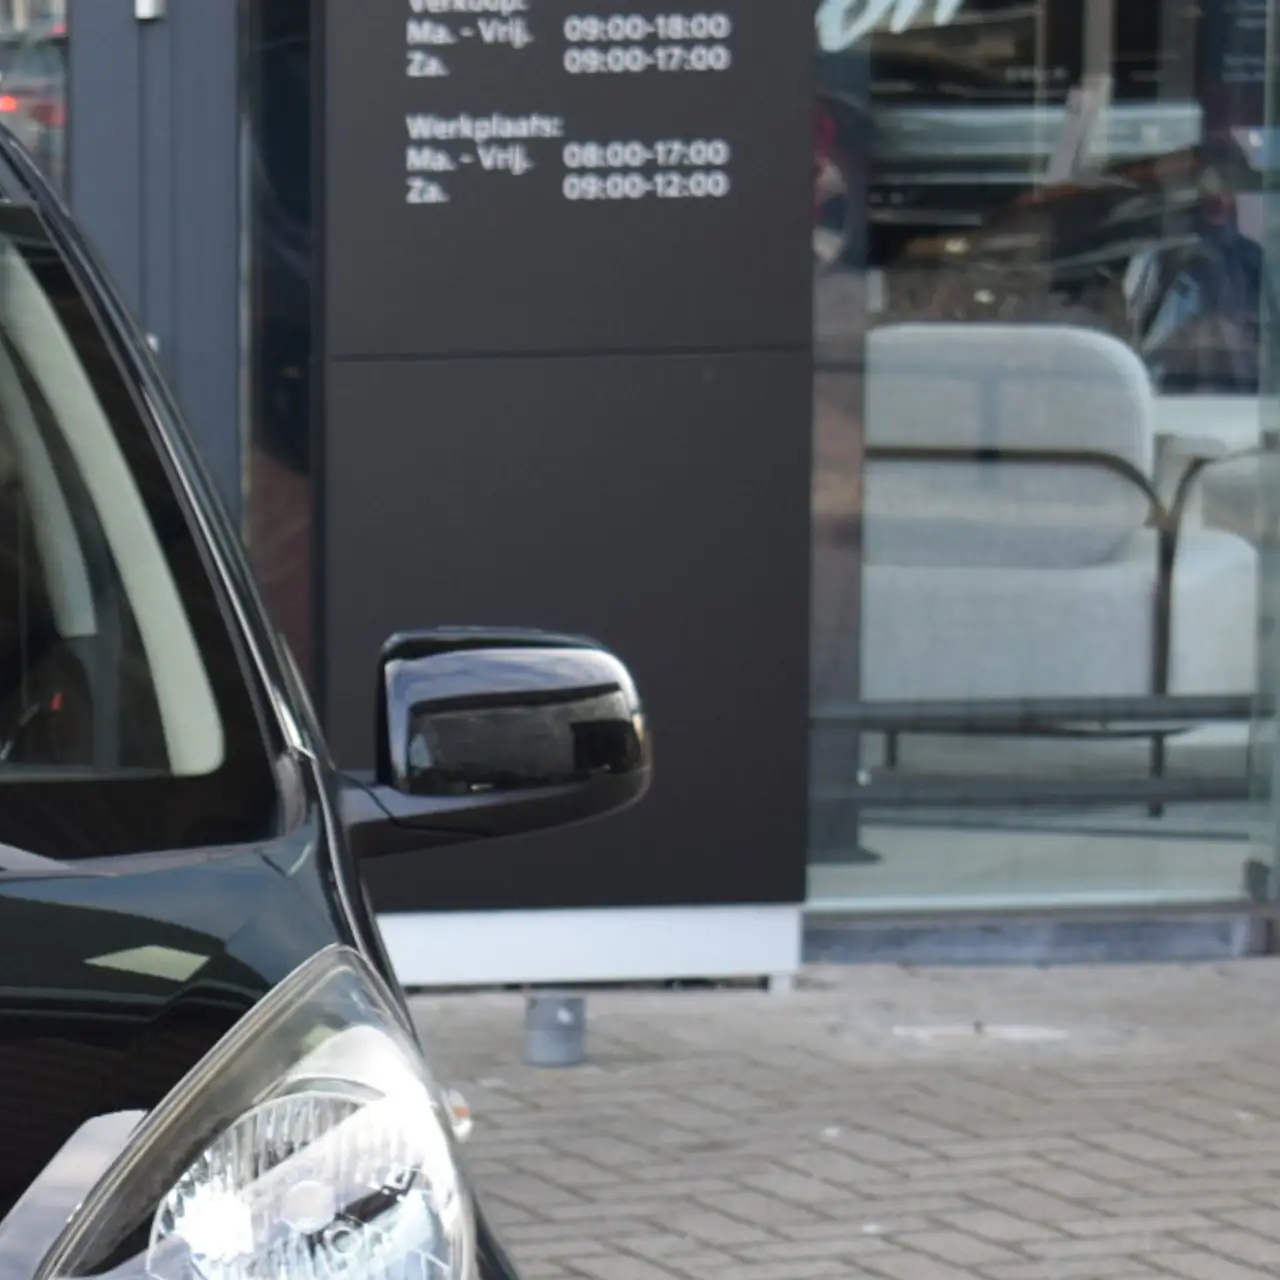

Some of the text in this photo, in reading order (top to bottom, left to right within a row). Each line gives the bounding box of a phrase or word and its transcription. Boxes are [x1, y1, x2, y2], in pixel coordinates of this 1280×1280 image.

[563, 13, 731, 41] 09:00-18:00
[563, 45, 731, 73] 09:00-17:00
[405, 113, 564, 143] Werkplaats:
[562, 139, 731, 168] 08:00-17:00
[562, 170, 730, 200] 09:00-12:00
